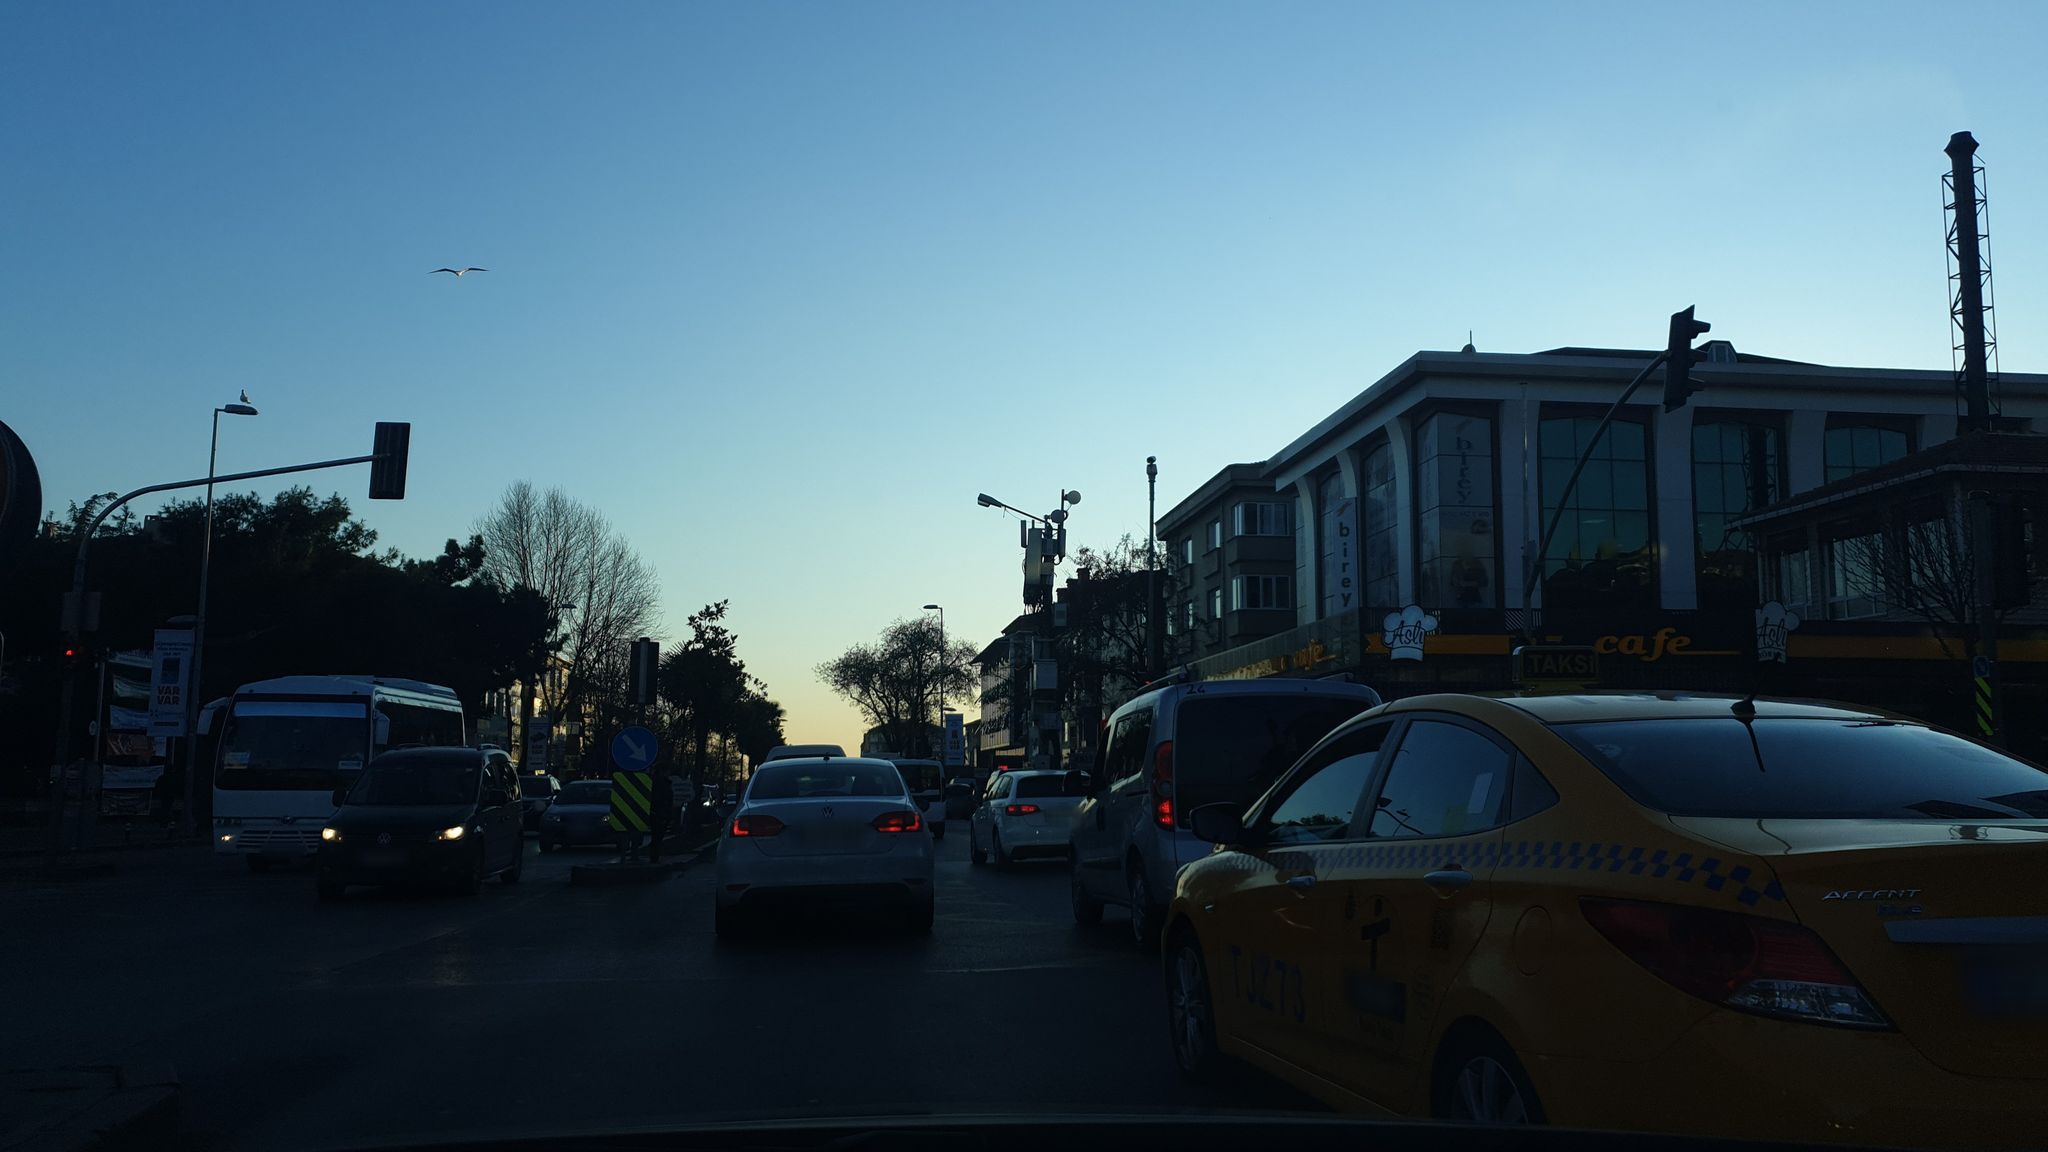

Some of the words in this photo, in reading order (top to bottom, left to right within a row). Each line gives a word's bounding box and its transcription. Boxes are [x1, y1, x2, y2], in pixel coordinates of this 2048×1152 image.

[1338, 521, 1351, 608] birey
[1592, 627, 1690, 661] cafe
[1822, 889, 1921, 902] ACCENT
